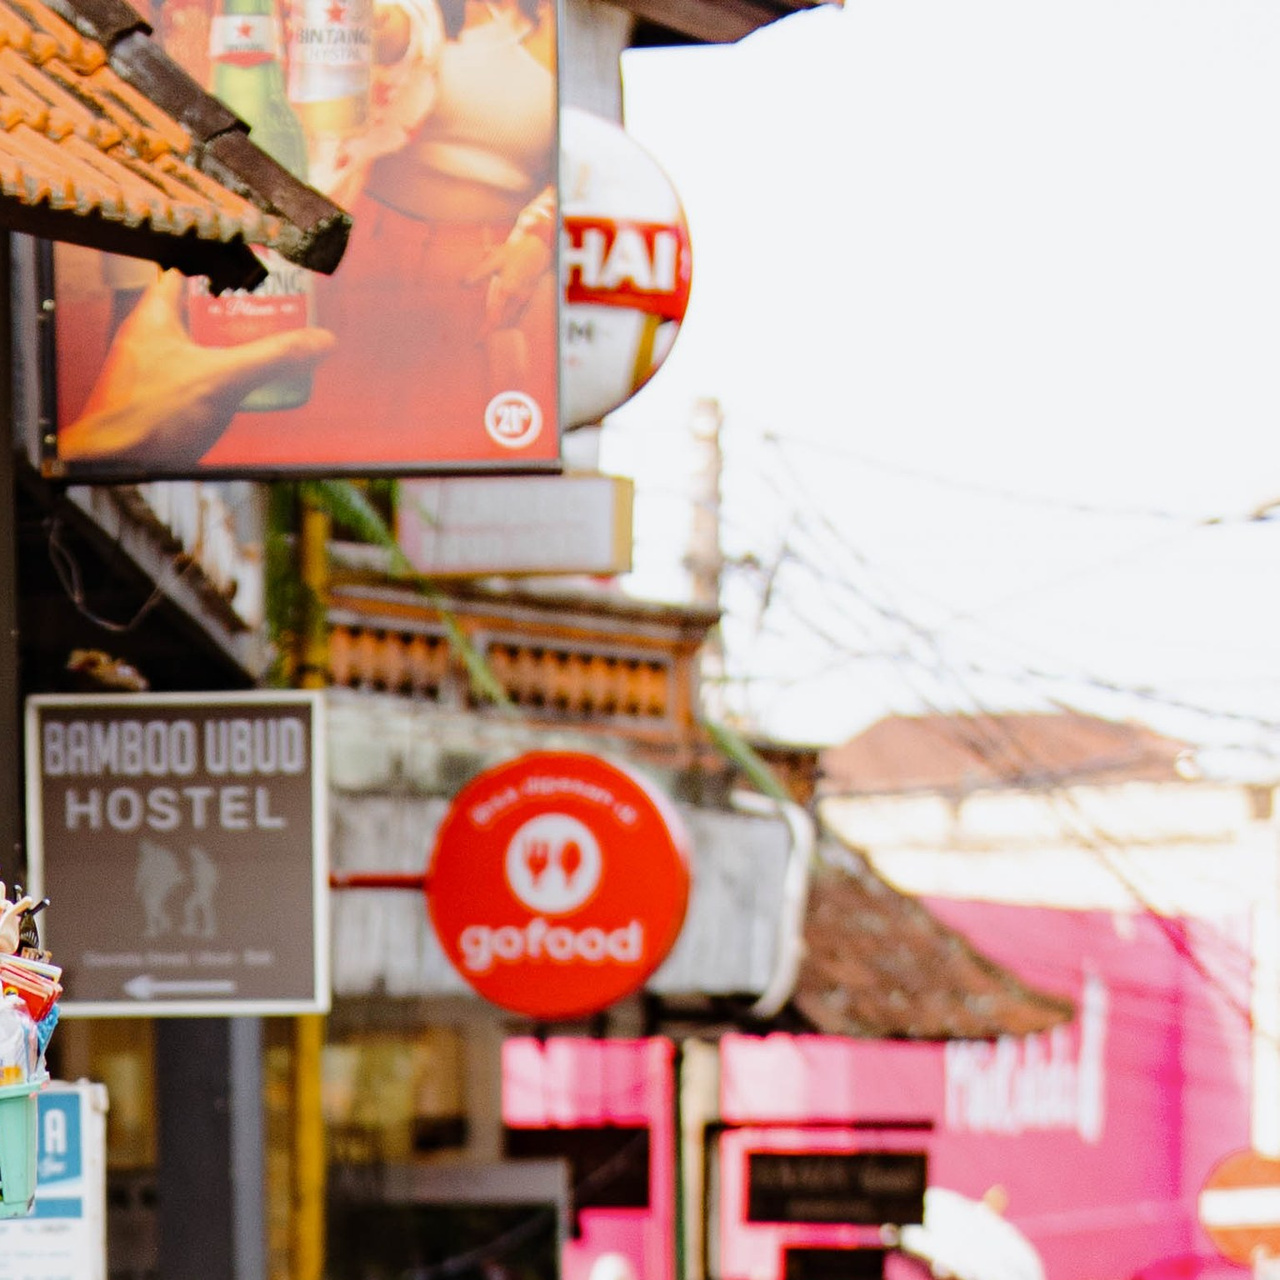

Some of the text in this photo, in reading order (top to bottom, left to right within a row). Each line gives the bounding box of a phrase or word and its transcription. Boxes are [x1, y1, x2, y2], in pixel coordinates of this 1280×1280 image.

[44, 716, 307, 777] BAMBOO UBUD
[64, 785, 288, 833] HOSTEL
[459, 917, 645, 972] gofood
